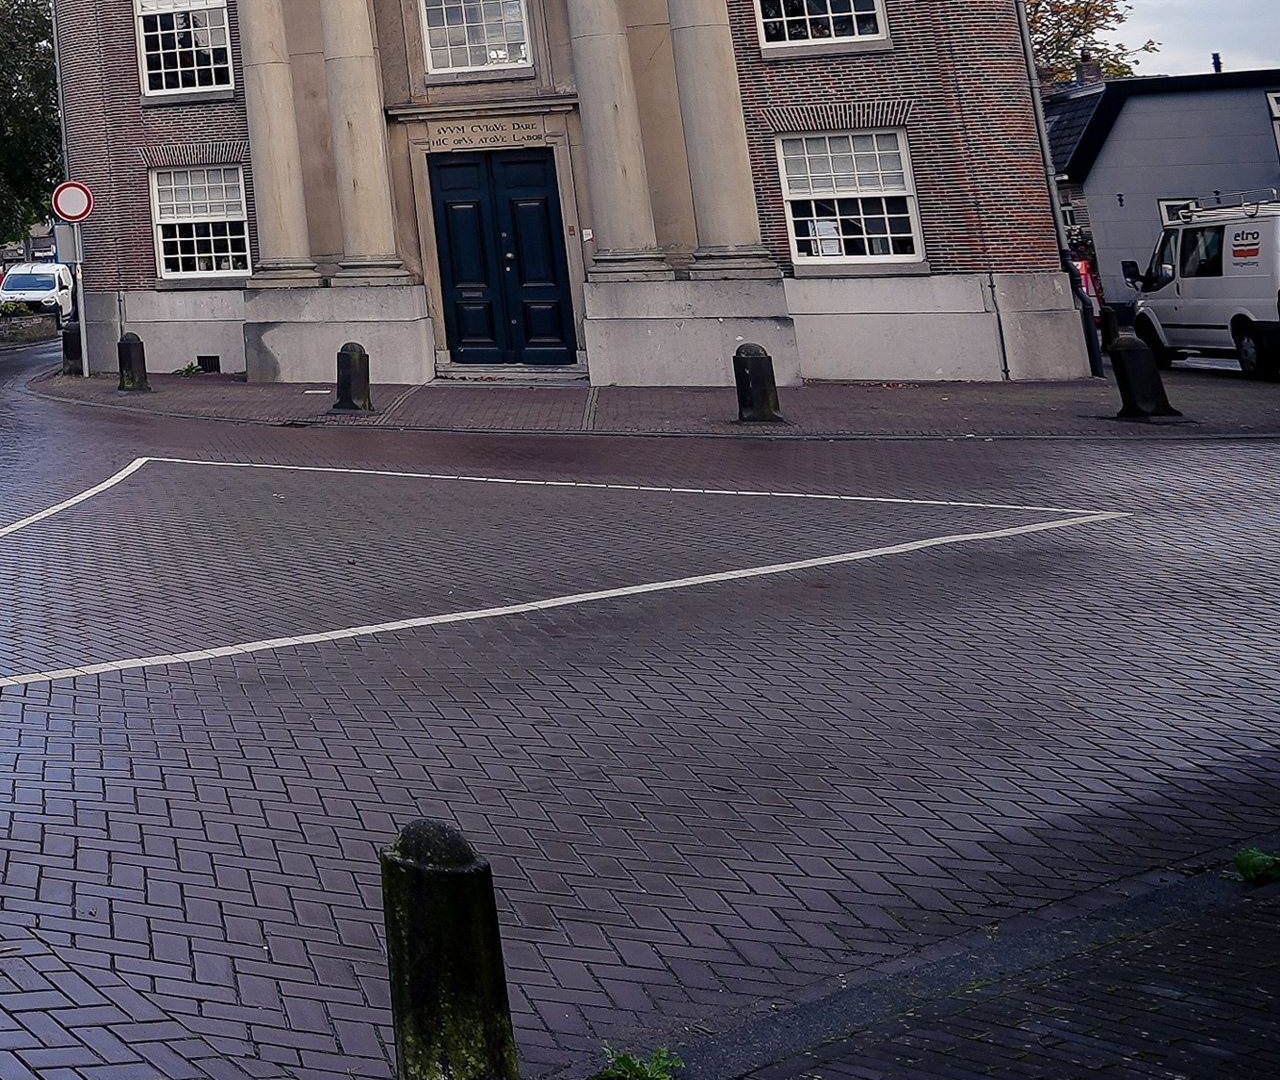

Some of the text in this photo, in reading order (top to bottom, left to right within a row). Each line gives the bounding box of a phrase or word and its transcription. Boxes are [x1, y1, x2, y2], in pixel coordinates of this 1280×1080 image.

[512, 122, 538, 131] DARE
[432, 137, 449, 147] HIC
[512, 133, 543, 142] LABOR
